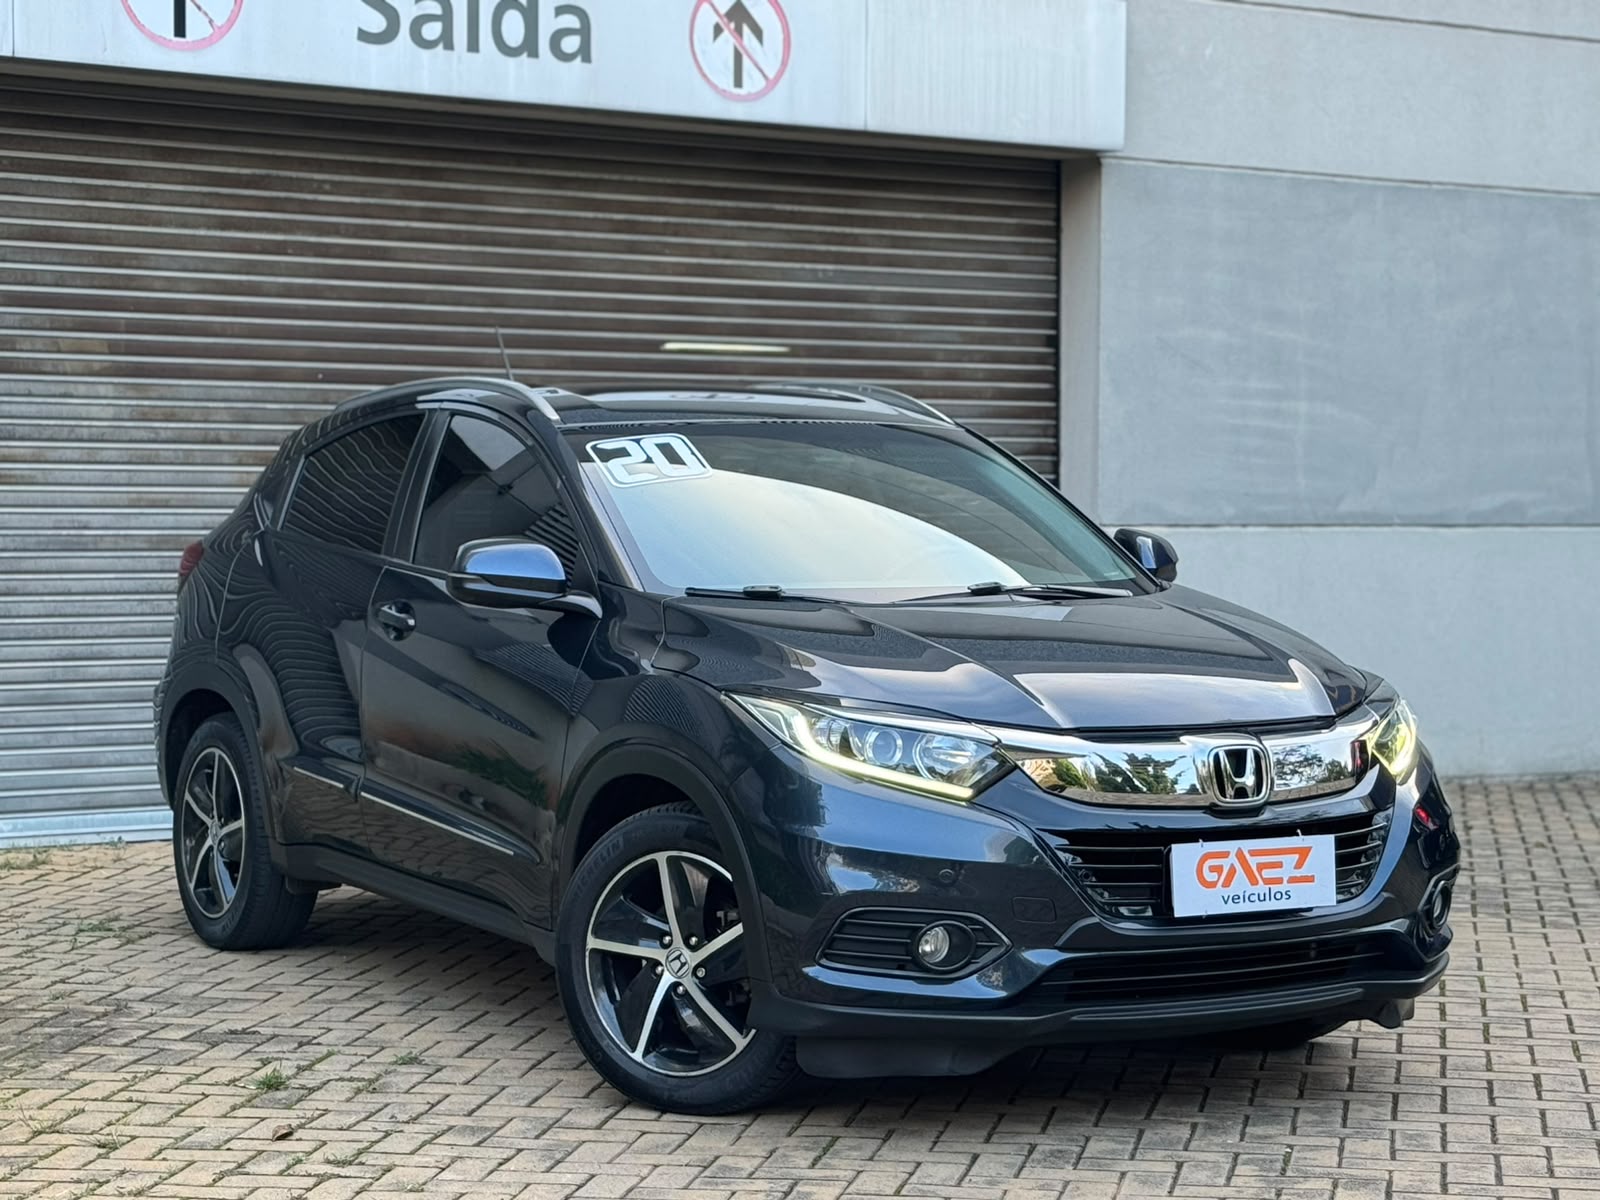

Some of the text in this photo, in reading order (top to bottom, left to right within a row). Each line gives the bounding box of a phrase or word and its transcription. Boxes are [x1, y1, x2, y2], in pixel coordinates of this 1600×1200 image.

[595, 436, 707, 484] 20
[1196, 846, 1315, 889] GAEZ
[1221, 887, 1292, 905] veículos
